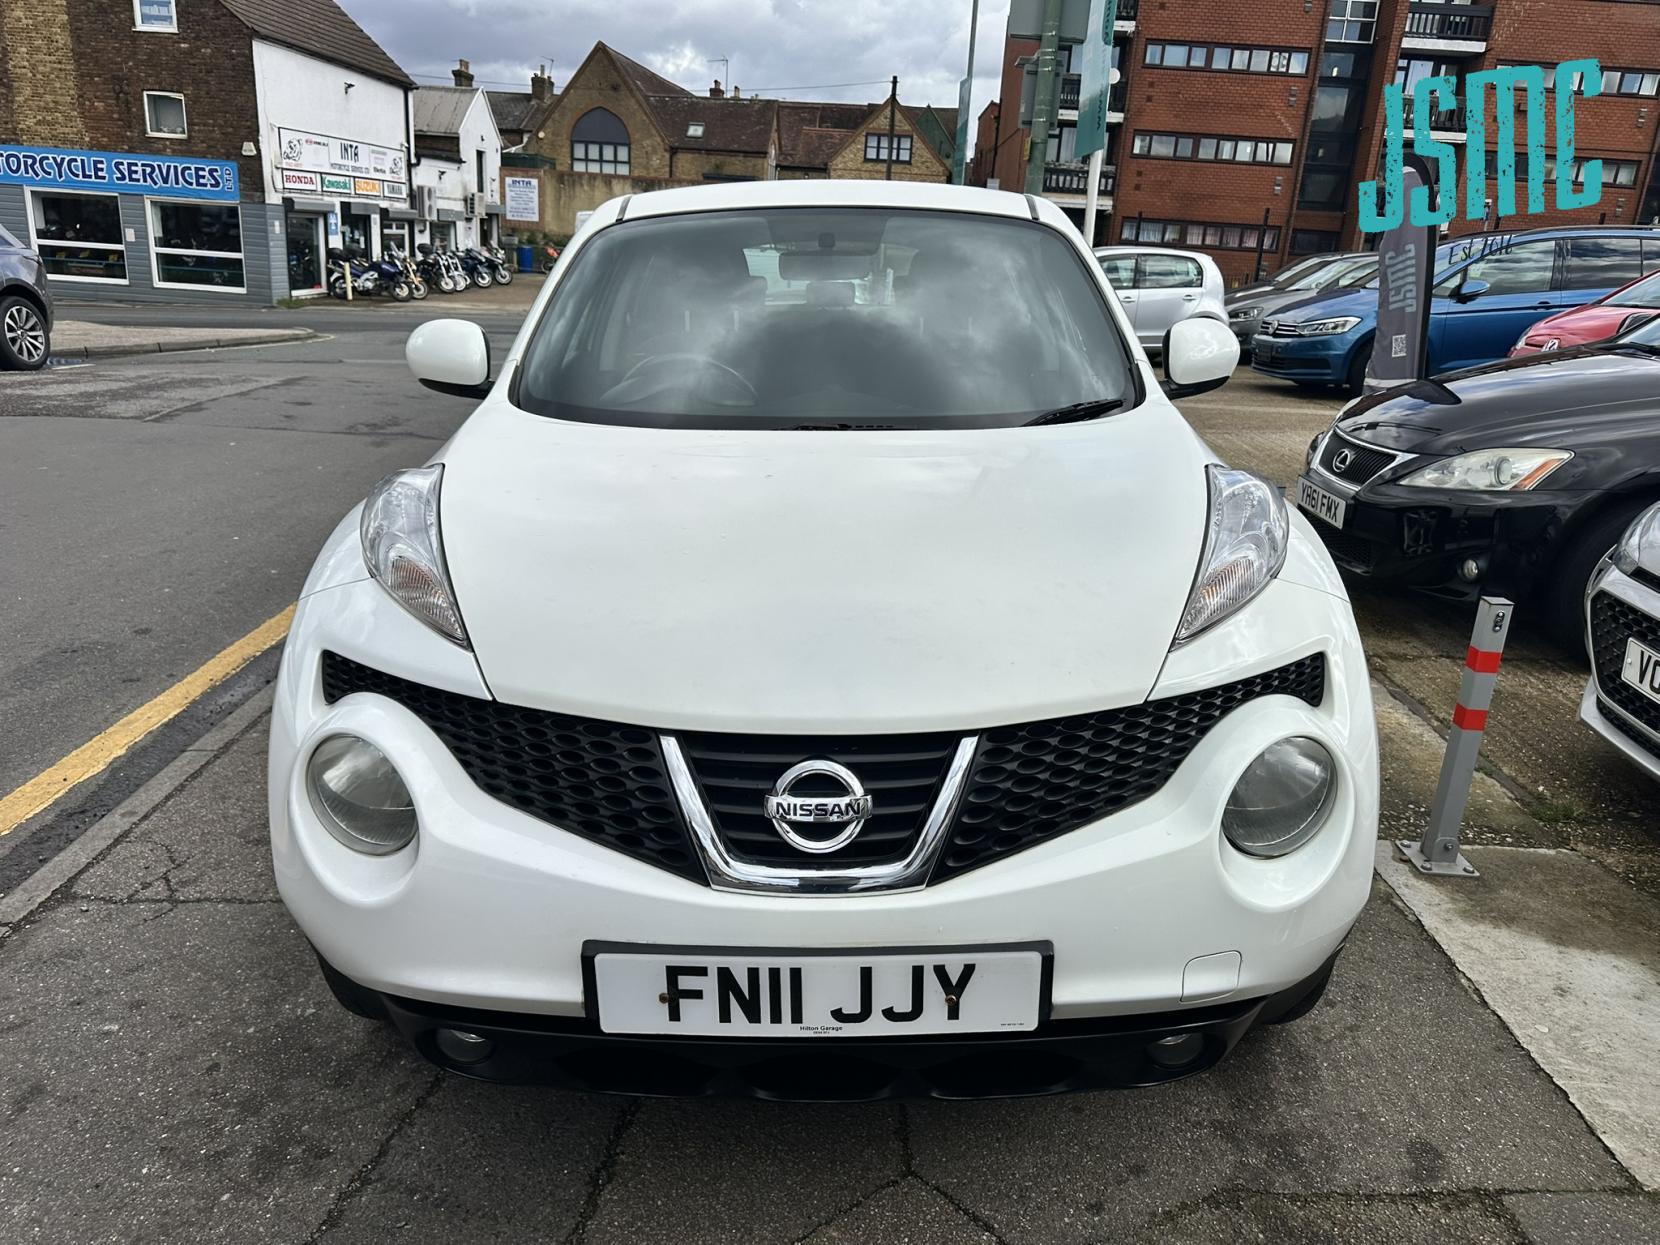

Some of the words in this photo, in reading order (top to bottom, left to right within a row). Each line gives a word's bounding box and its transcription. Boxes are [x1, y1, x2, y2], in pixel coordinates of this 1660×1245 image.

[340, 142, 359, 162] INTA
[112, 159, 222, 189] SERVICES
[224, 167, 233, 191] LTD
[284, 174, 315, 185] HONDA
[322, 175, 351, 190] Kawasaki
[511, 179, 532, 187] INTA
[355, 179, 379, 193] SUZUKI
[1385, 243, 1416, 312] JSMC
[1319, 493, 1340, 523] FMX
[775, 801, 861, 817] NISSAN
[665, 965, 804, 1024] FN11
[829, 963, 976, 1024] JJY
